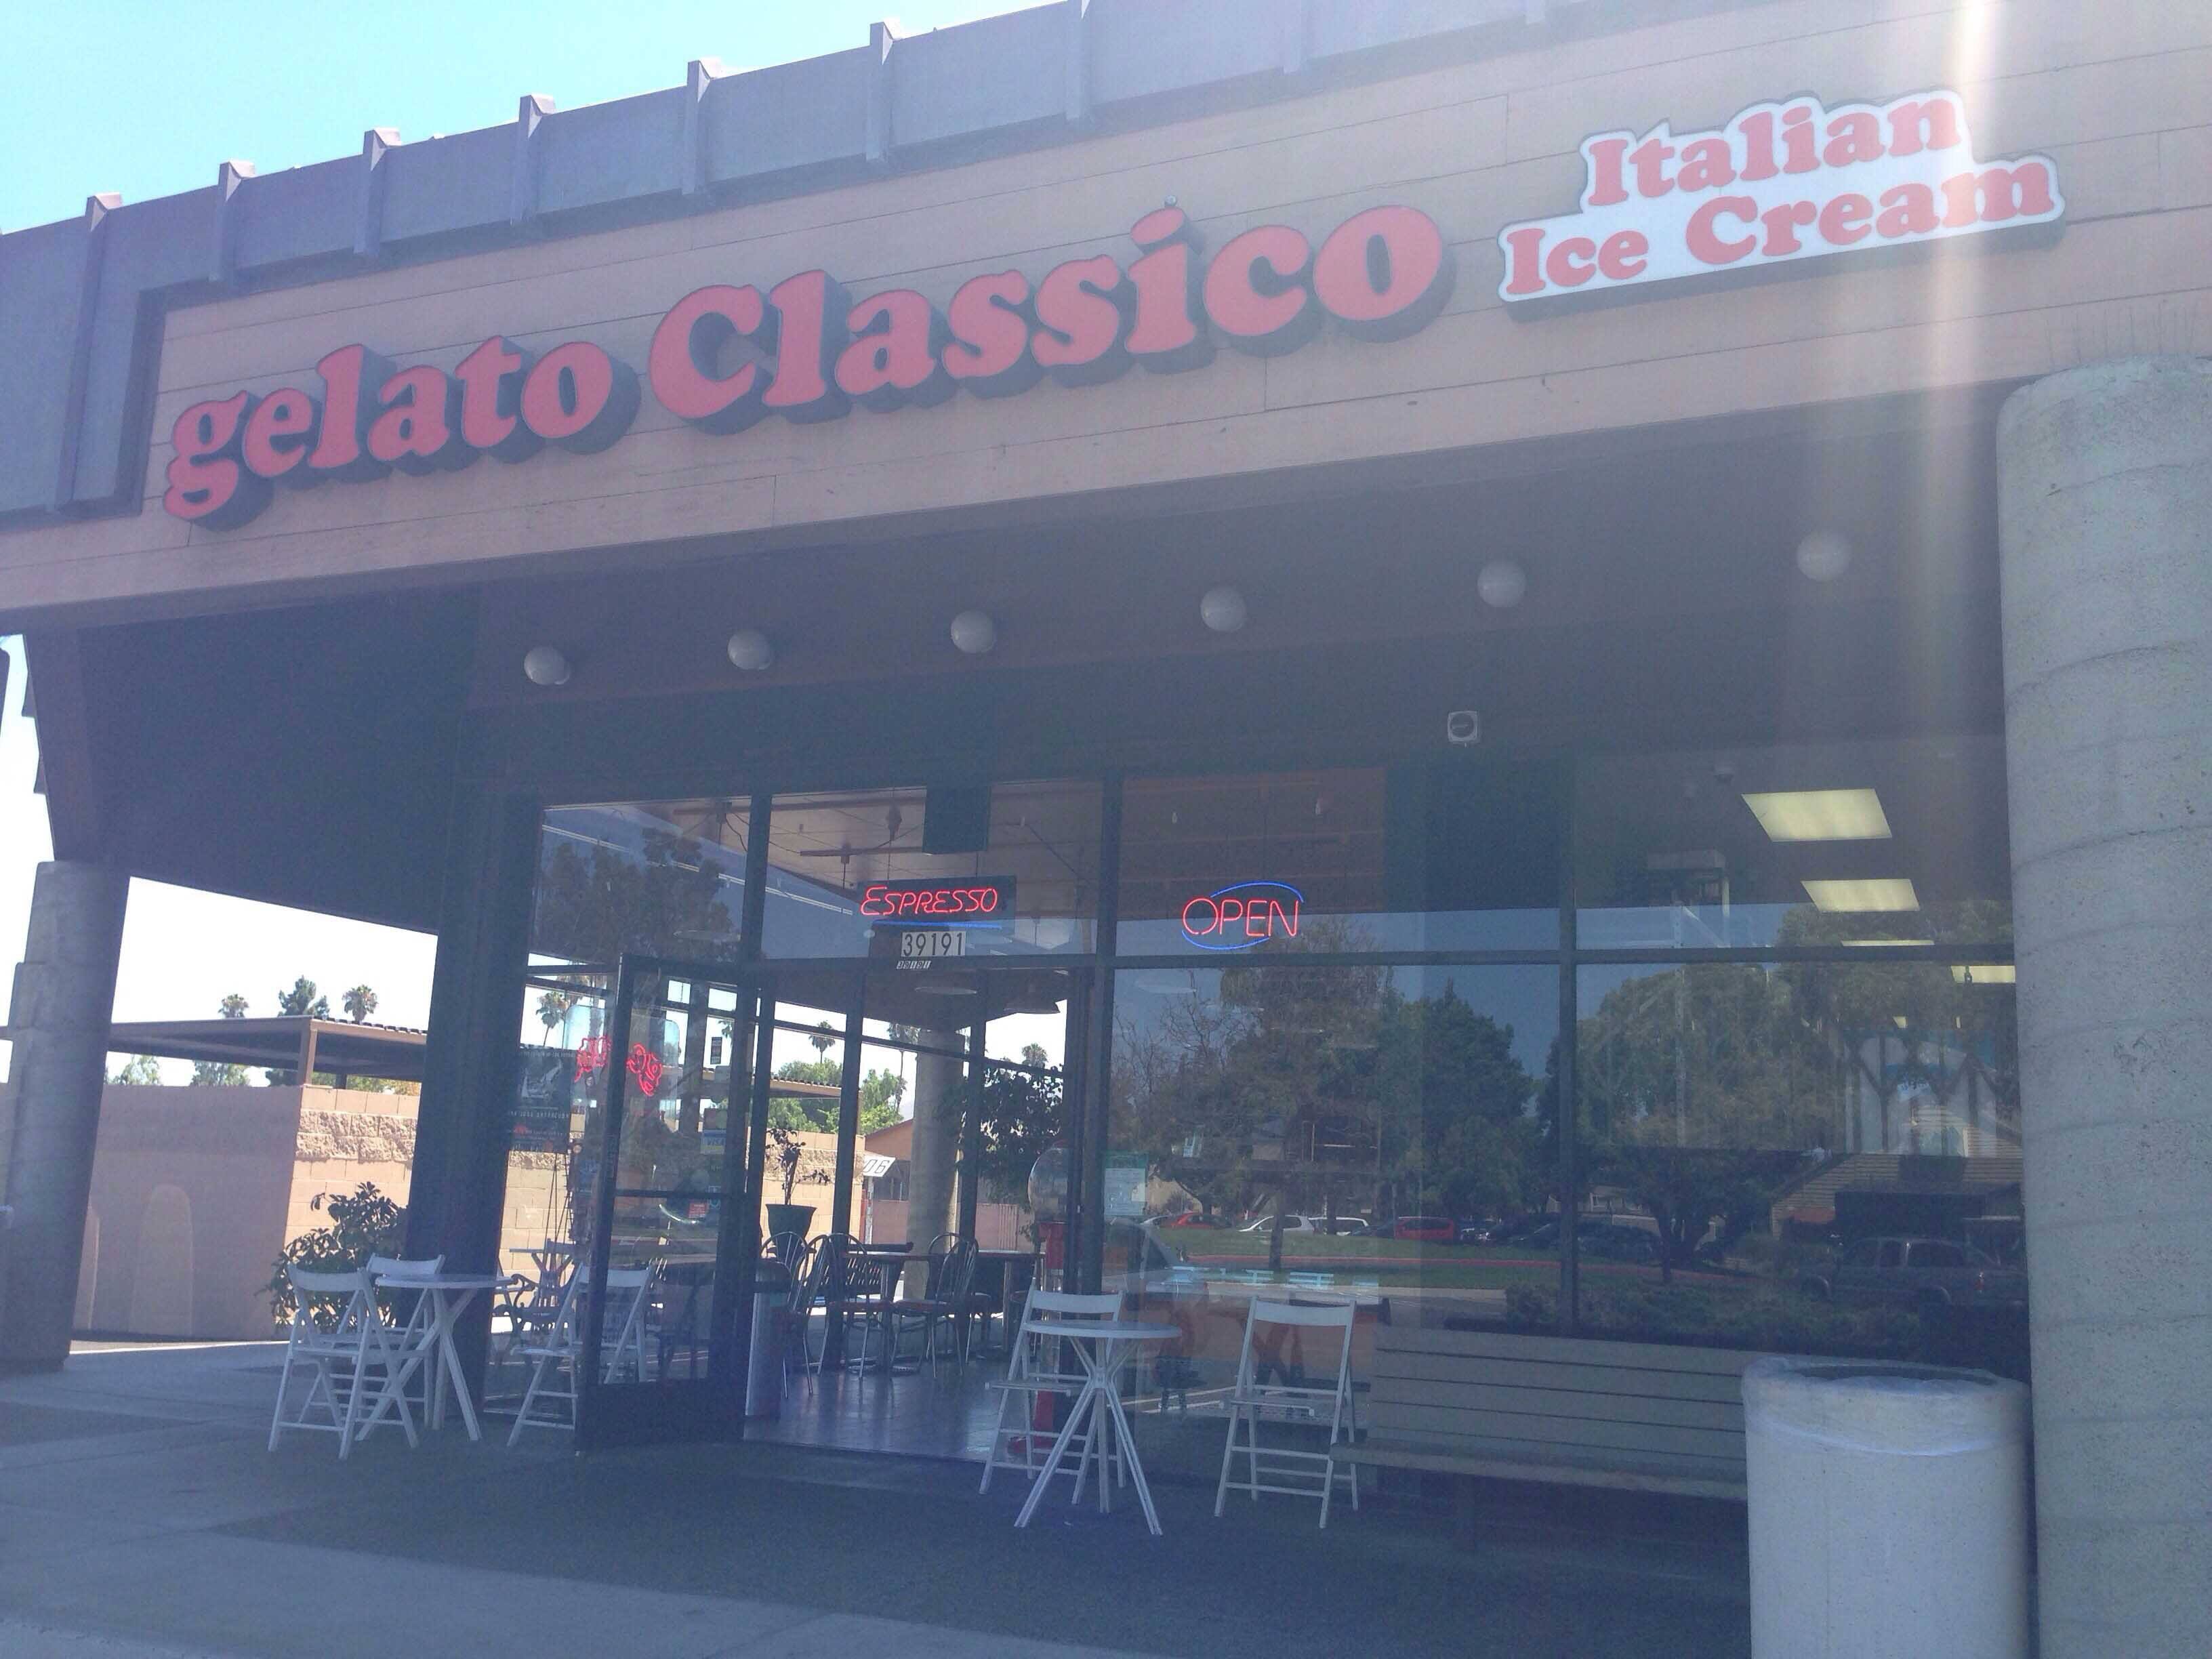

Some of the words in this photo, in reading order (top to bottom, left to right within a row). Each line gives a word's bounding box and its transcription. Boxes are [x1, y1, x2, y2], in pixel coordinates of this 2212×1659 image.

[1587, 98, 1962, 206] Italian
[1505, 227, 1649, 295] Ice
[1685, 160, 2056, 266] Cream
[163, 335, 613, 519] gelato
[649, 204, 1443, 419] Classico
[860, 884, 998, 916] ESPRESSO
[1182, 897, 1299, 937] OPEN
[903, 931, 963, 956] 39191
